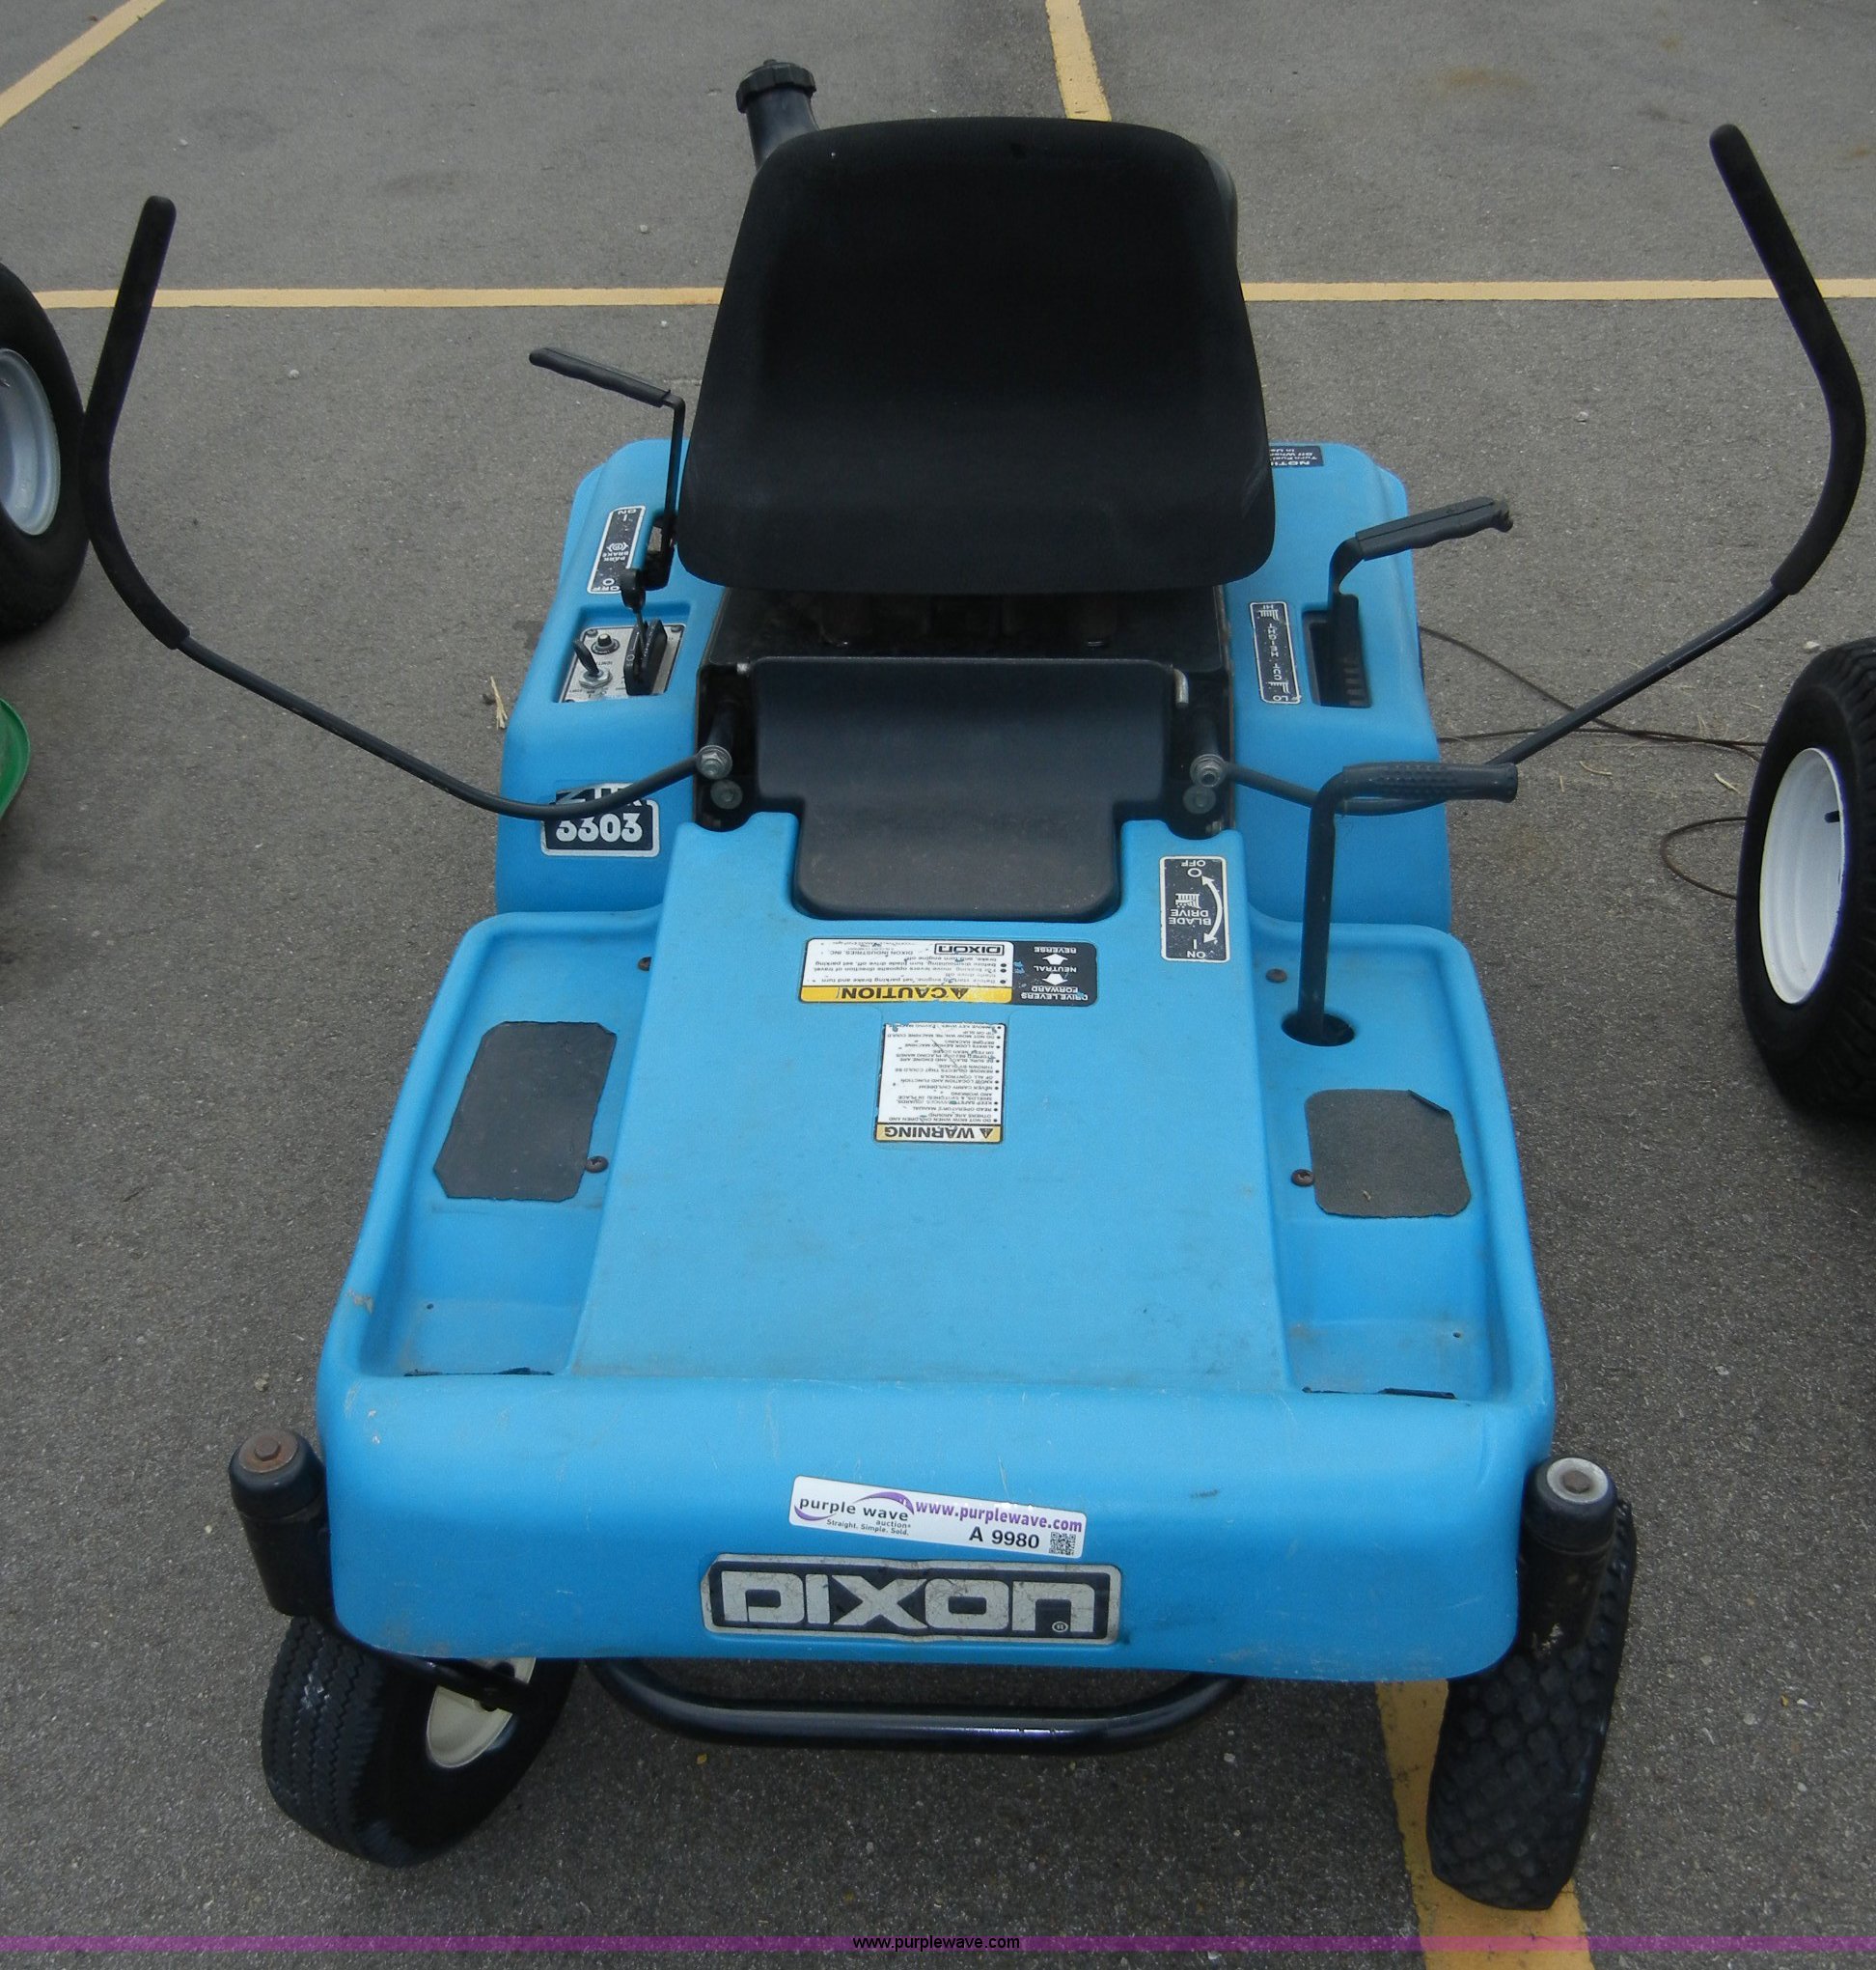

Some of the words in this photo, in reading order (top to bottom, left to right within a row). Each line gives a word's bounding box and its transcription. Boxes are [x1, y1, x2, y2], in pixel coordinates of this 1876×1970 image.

[1268, 624, 1279, 657] HEIGHT
[1273, 663, 1282, 680] CUT
[1169, 917, 1211, 926] BLADE
[841, 987, 947, 998] CAUTION
[885, 1126, 975, 1139] WARNING
[800, 1498, 856, 1514] purple
[864, 1508, 908, 1521] wave
[916, 1501, 1082, 1532] www.purplewave.com
[827, 1519, 858, 1529] Straight.
[861, 1524, 888, 1533] Simple.
[969, 1526, 983, 1542] A
[991, 1529, 1039, 1549] 9980
[722, 1570, 1096, 1633] DIXON
